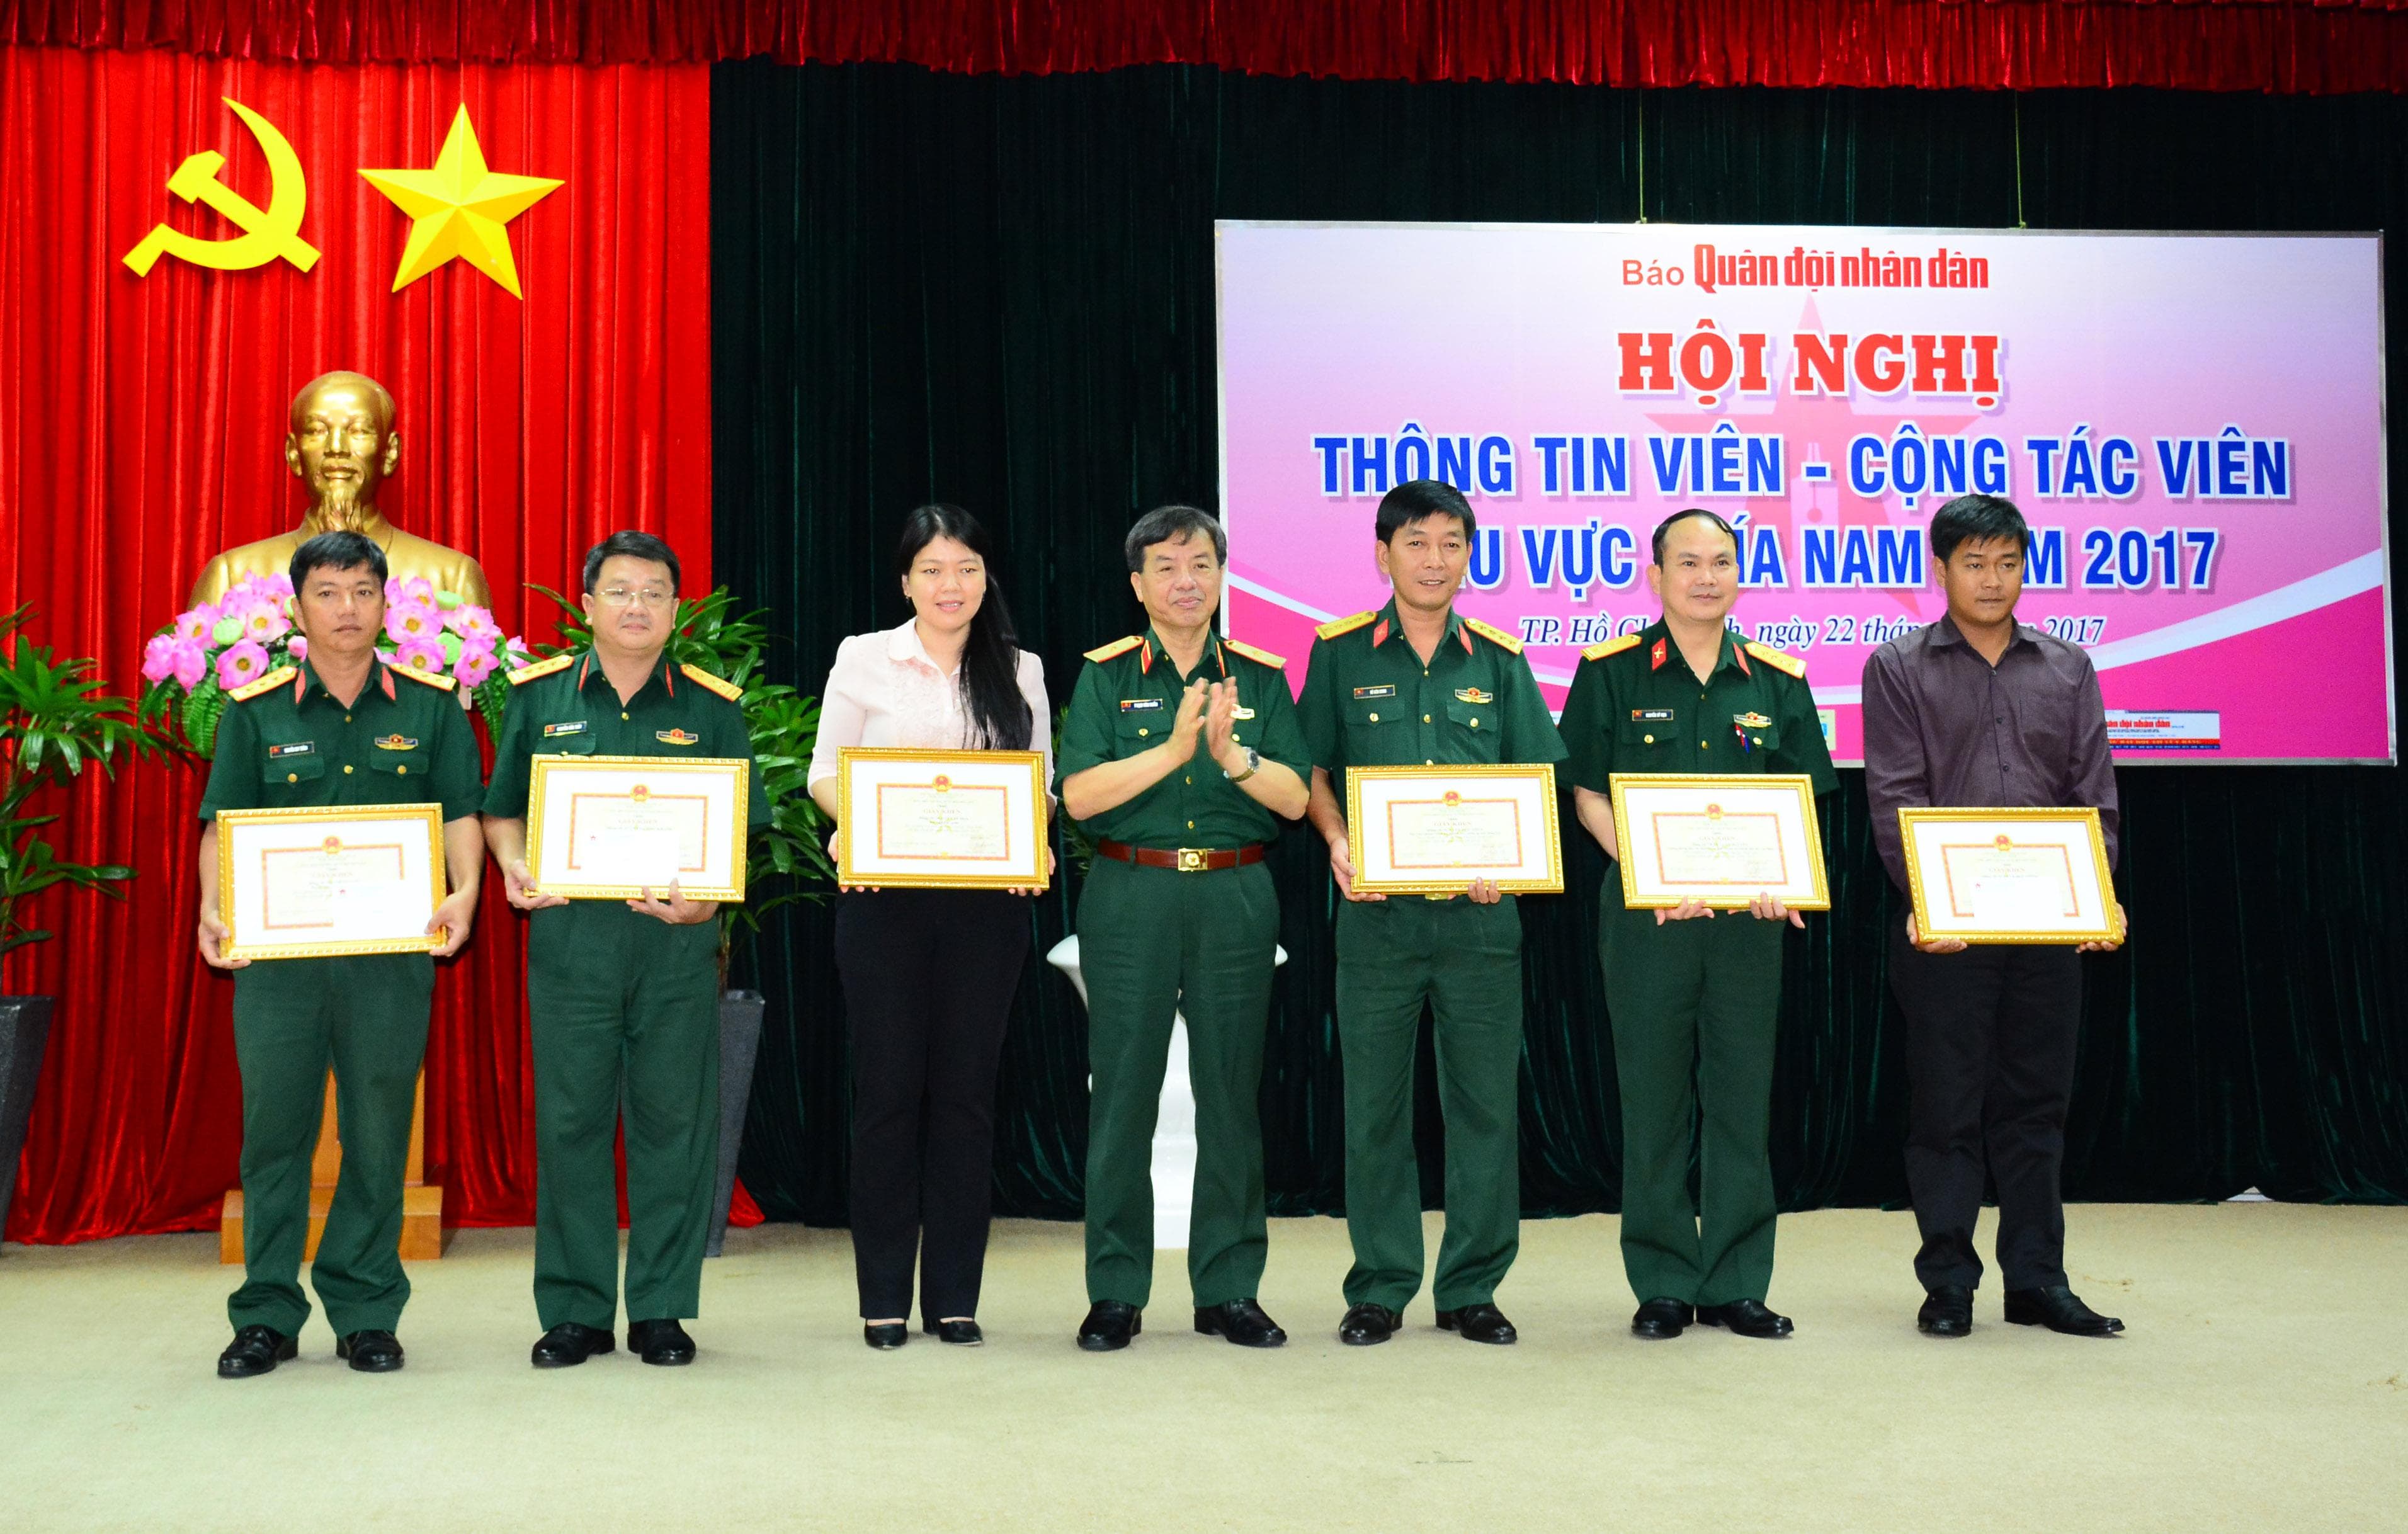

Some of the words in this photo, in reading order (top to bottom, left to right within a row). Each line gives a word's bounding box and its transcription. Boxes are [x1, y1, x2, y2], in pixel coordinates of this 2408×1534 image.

[1622, 255, 1684, 287] Báo
[1694, 244, 1778, 294] Quân
[1783, 246, 1835, 292] đội
[1841, 247, 1922, 288] nhân
[1928, 248, 1989, 288] dân
[1617, 318, 1768, 406] HỘI
[1793, 333, 1999, 407] NGHỊ
[1314, 423, 1513, 493] THÔNG
[1534, 436, 1627, 492] TIN
[1649, 423, 1781, 492] VIÊN
[1805, 465, 1827, 478] -
[1850, 424, 2007, 507] CỘNG
[2027, 425, 2136, 496] TÁC
[2156, 426, 2288, 496] VIÊN
[1521, 518, 1634, 598] VỰC
[1804, 529, 1923, 585] NAM
[2084, 530, 2217, 586] 2017
[1521, 618, 1559, 643] TP.
[1569, 613, 1608, 643] Hồ
[1758, 617, 1817, 649] ngày
[1825, 618, 1853, 642] 22
[2046, 618, 2104, 643] 2017
